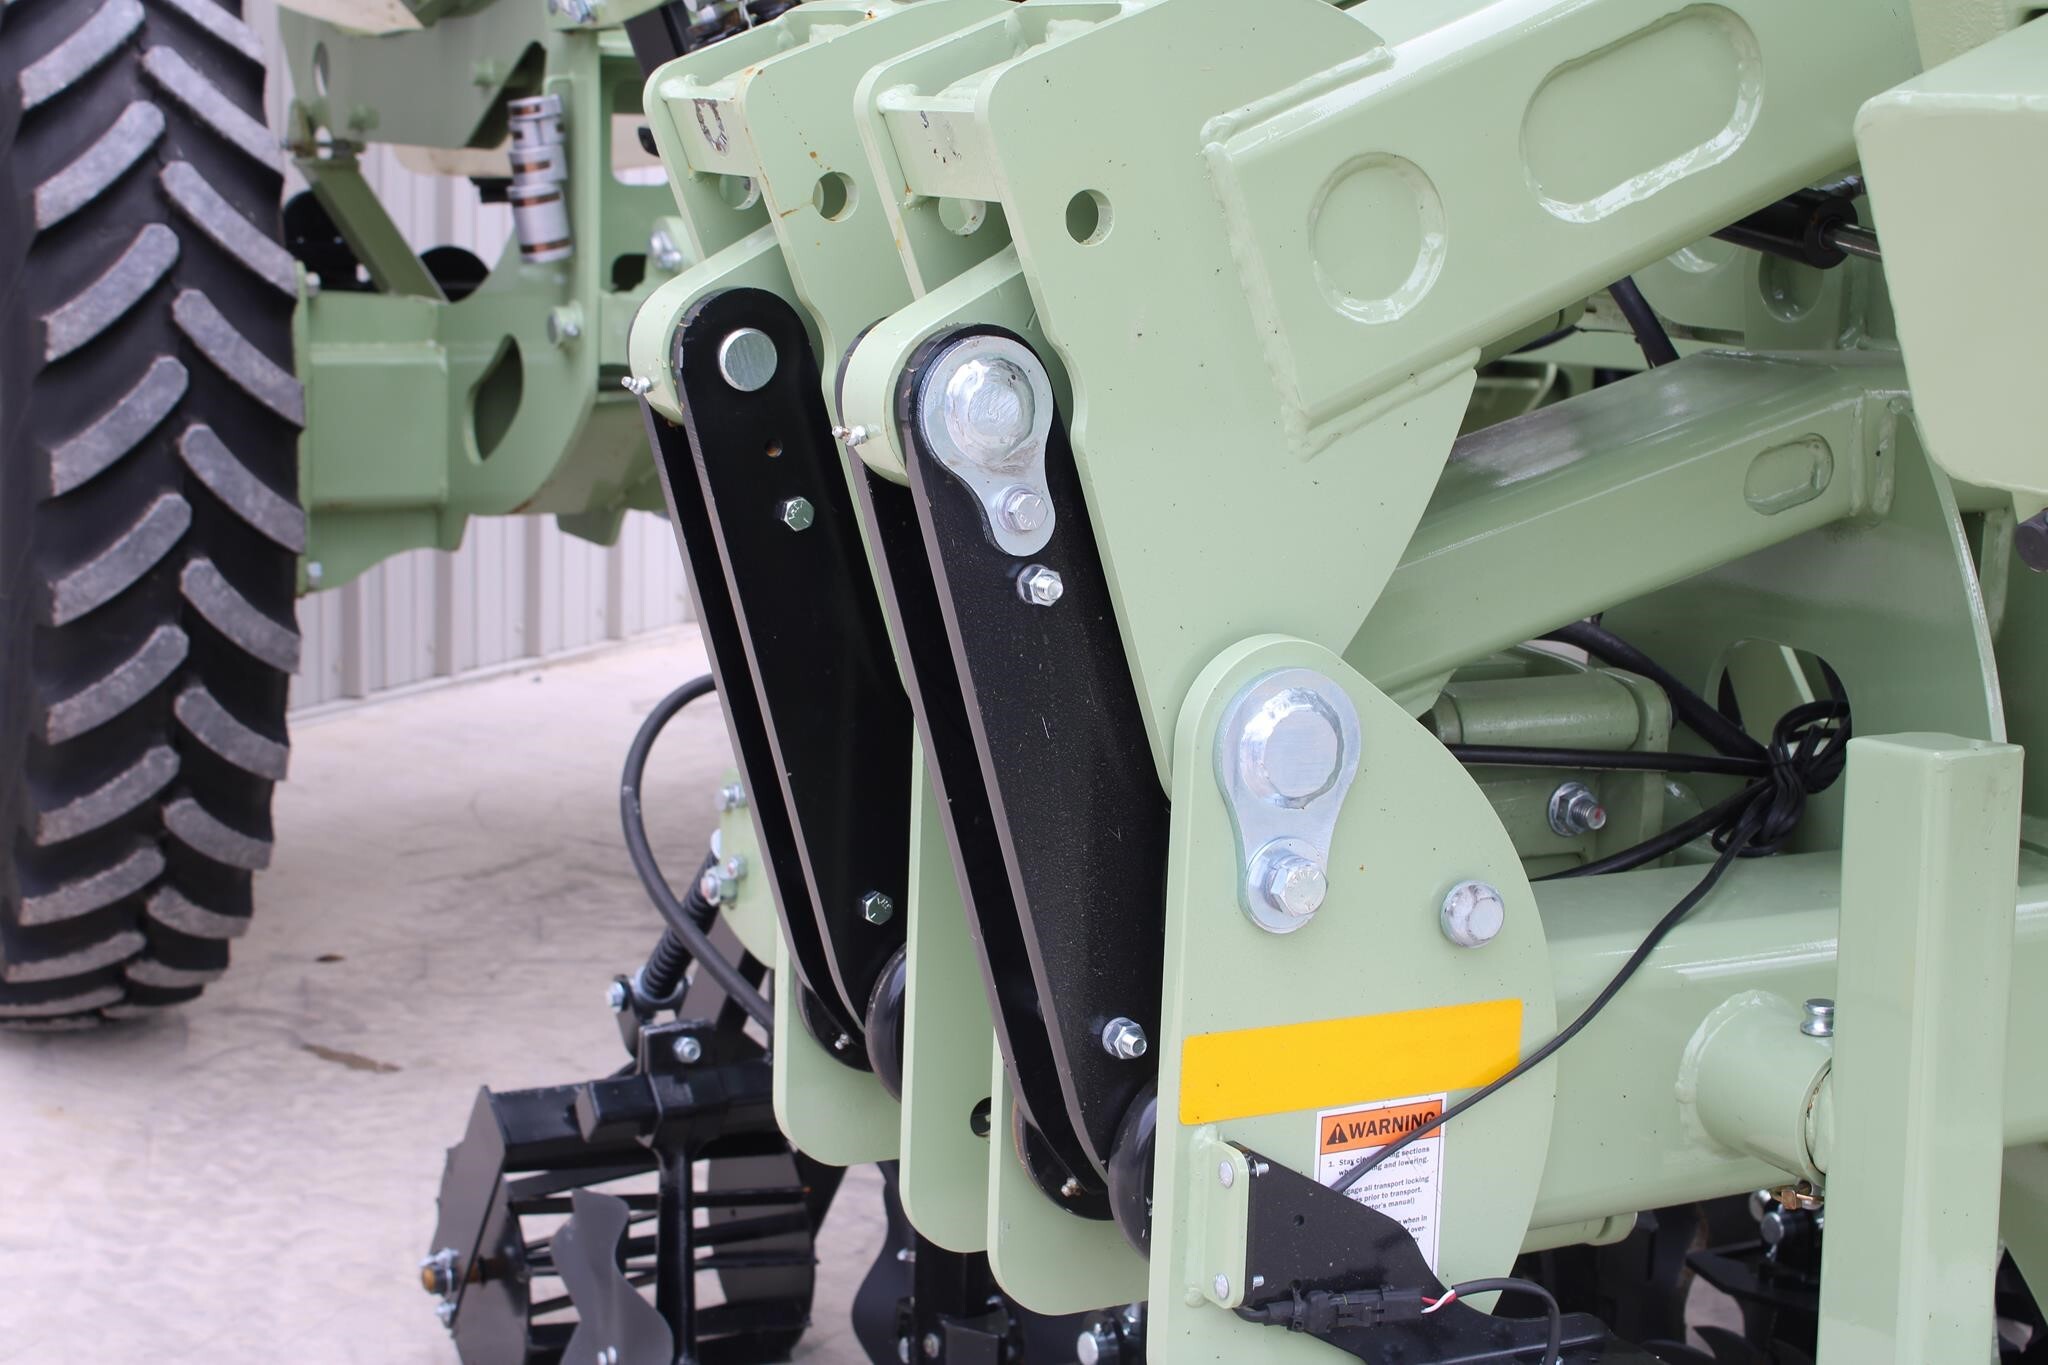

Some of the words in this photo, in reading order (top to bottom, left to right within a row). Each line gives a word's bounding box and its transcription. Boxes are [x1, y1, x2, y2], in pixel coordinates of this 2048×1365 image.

[1349, 1111, 1435, 1139] WARNING
[1338, 1158, 1354, 1167] Stay
[1402, 1147, 1430, 1156] sections
[1398, 1156, 1429, 1166] lowering.
[1374, 1180, 1404, 1190] transport
[1406, 1176, 1430, 1185] locking
[1364, 1194, 1380, 1202] prior
[1390, 1186, 1422, 1198] transport.
[1388, 1198, 1416, 1207] manual)
[1403, 1216, 1420, 1224] when
